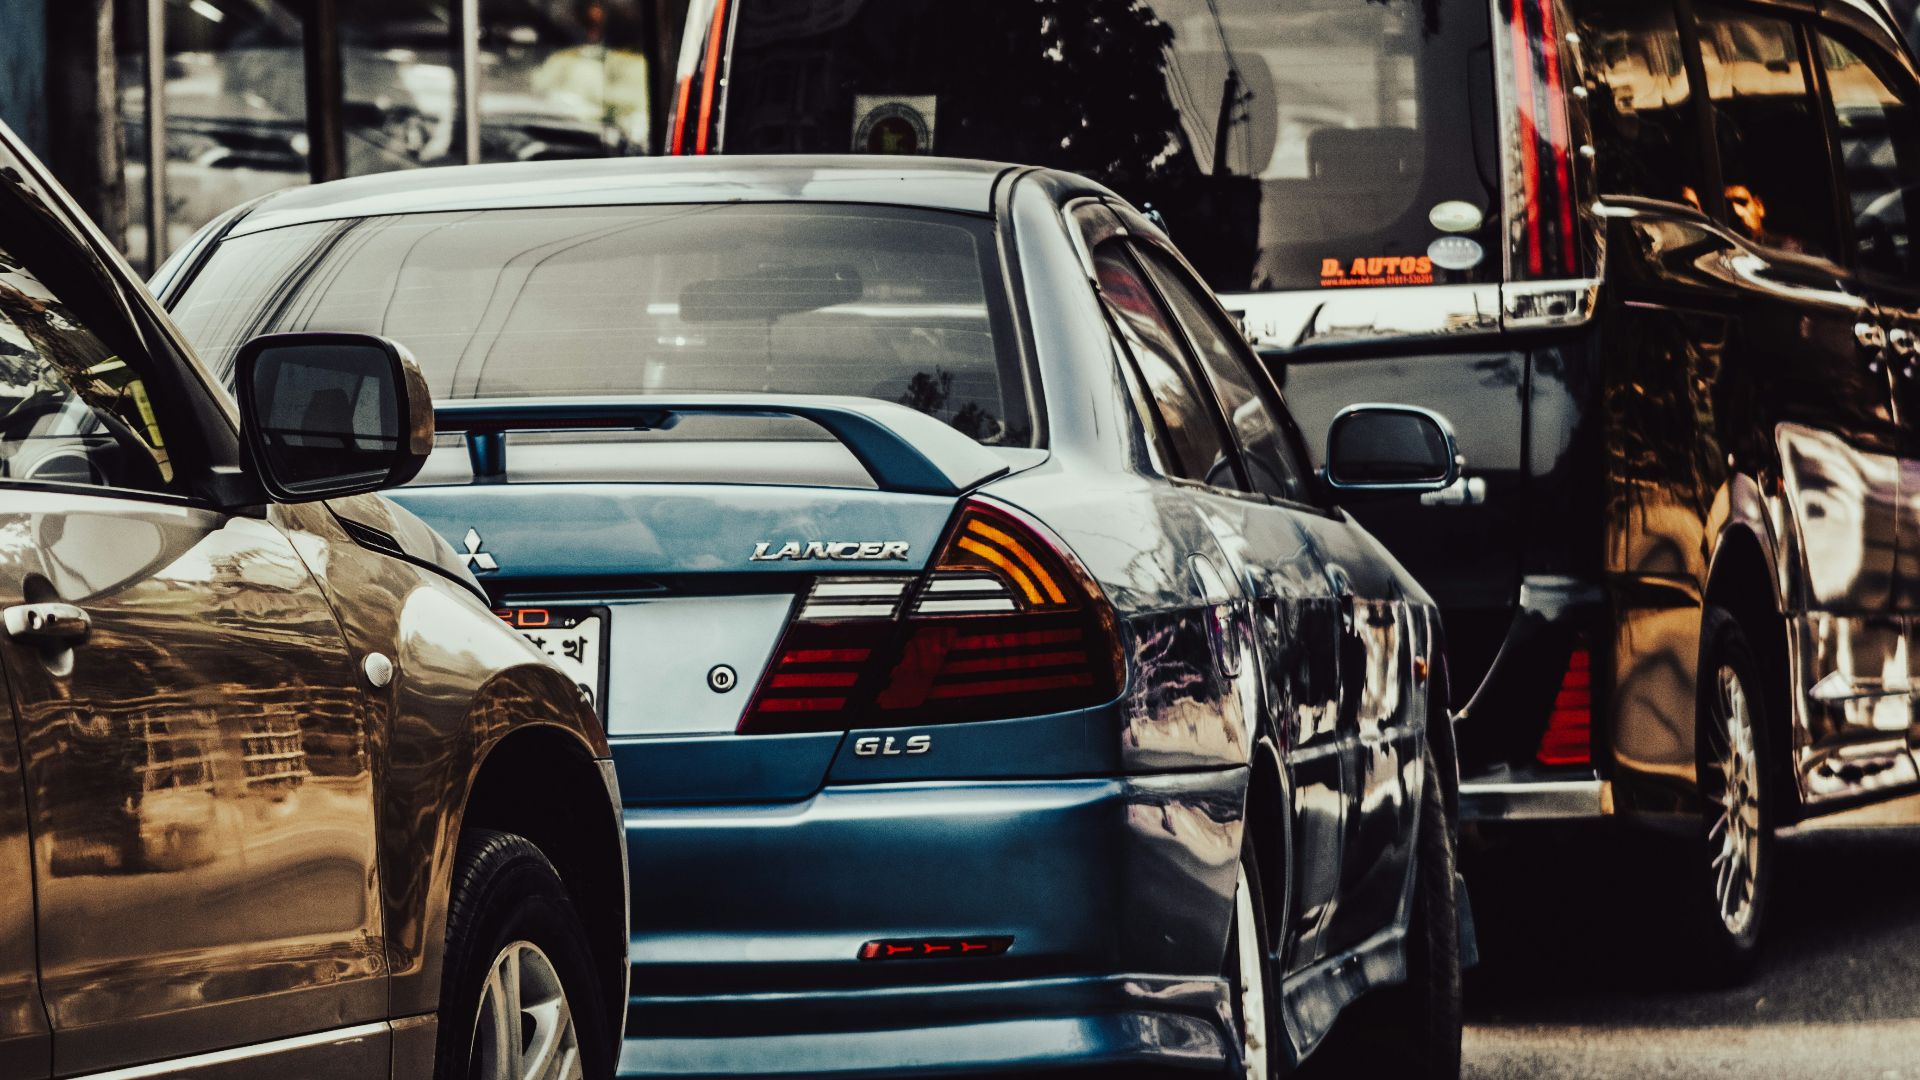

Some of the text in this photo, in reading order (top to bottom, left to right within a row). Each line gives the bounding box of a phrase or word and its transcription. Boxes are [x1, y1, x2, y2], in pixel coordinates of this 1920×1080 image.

[1320, 256, 1433, 277] D. AUTOS
[749, 540, 911, 562] LANCER
[854, 734, 932, 756] GLS
